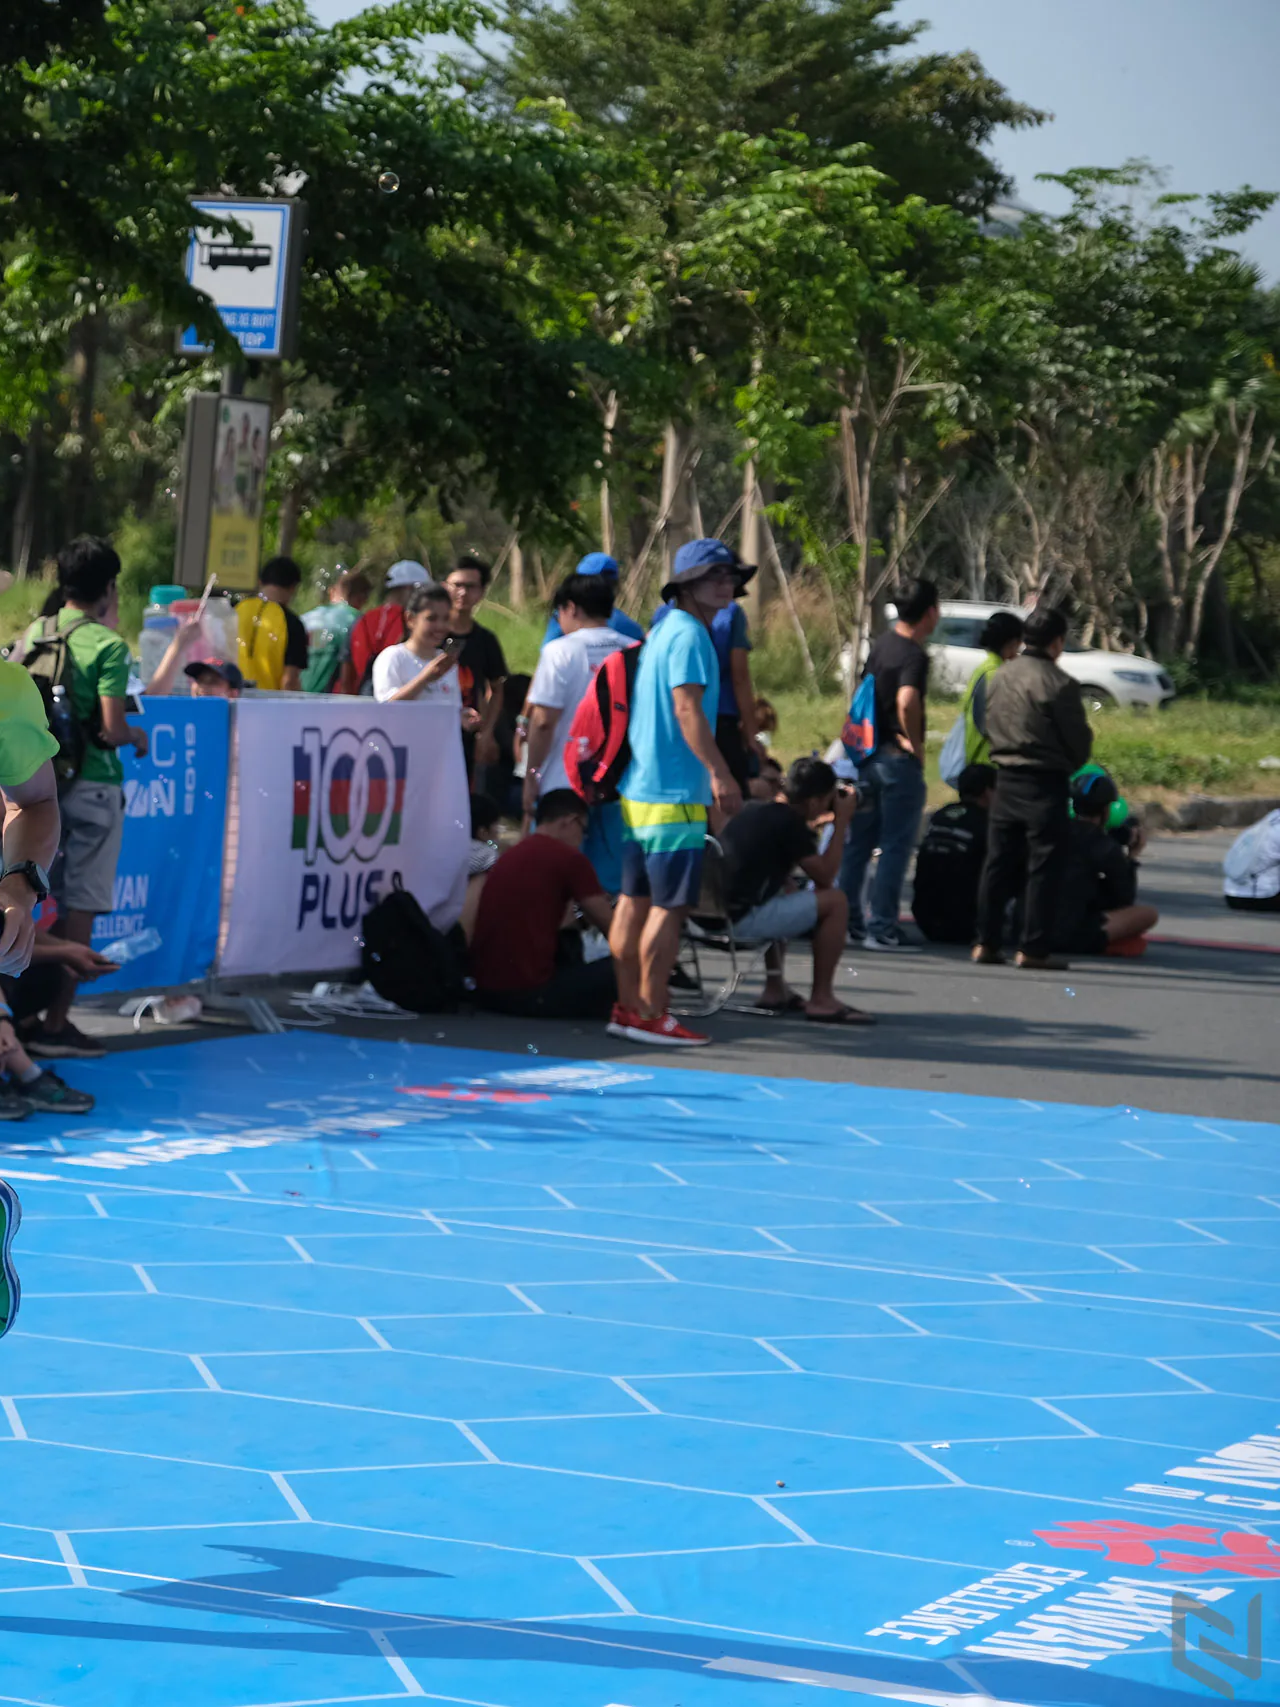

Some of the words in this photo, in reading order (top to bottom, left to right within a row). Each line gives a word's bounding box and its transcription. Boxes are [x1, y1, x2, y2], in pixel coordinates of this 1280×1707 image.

[302, 727, 396, 866] 100
[865, 1562, 1088, 1646] EXCELLENCE
[964, 1576, 1235, 1669] TAIWAN
